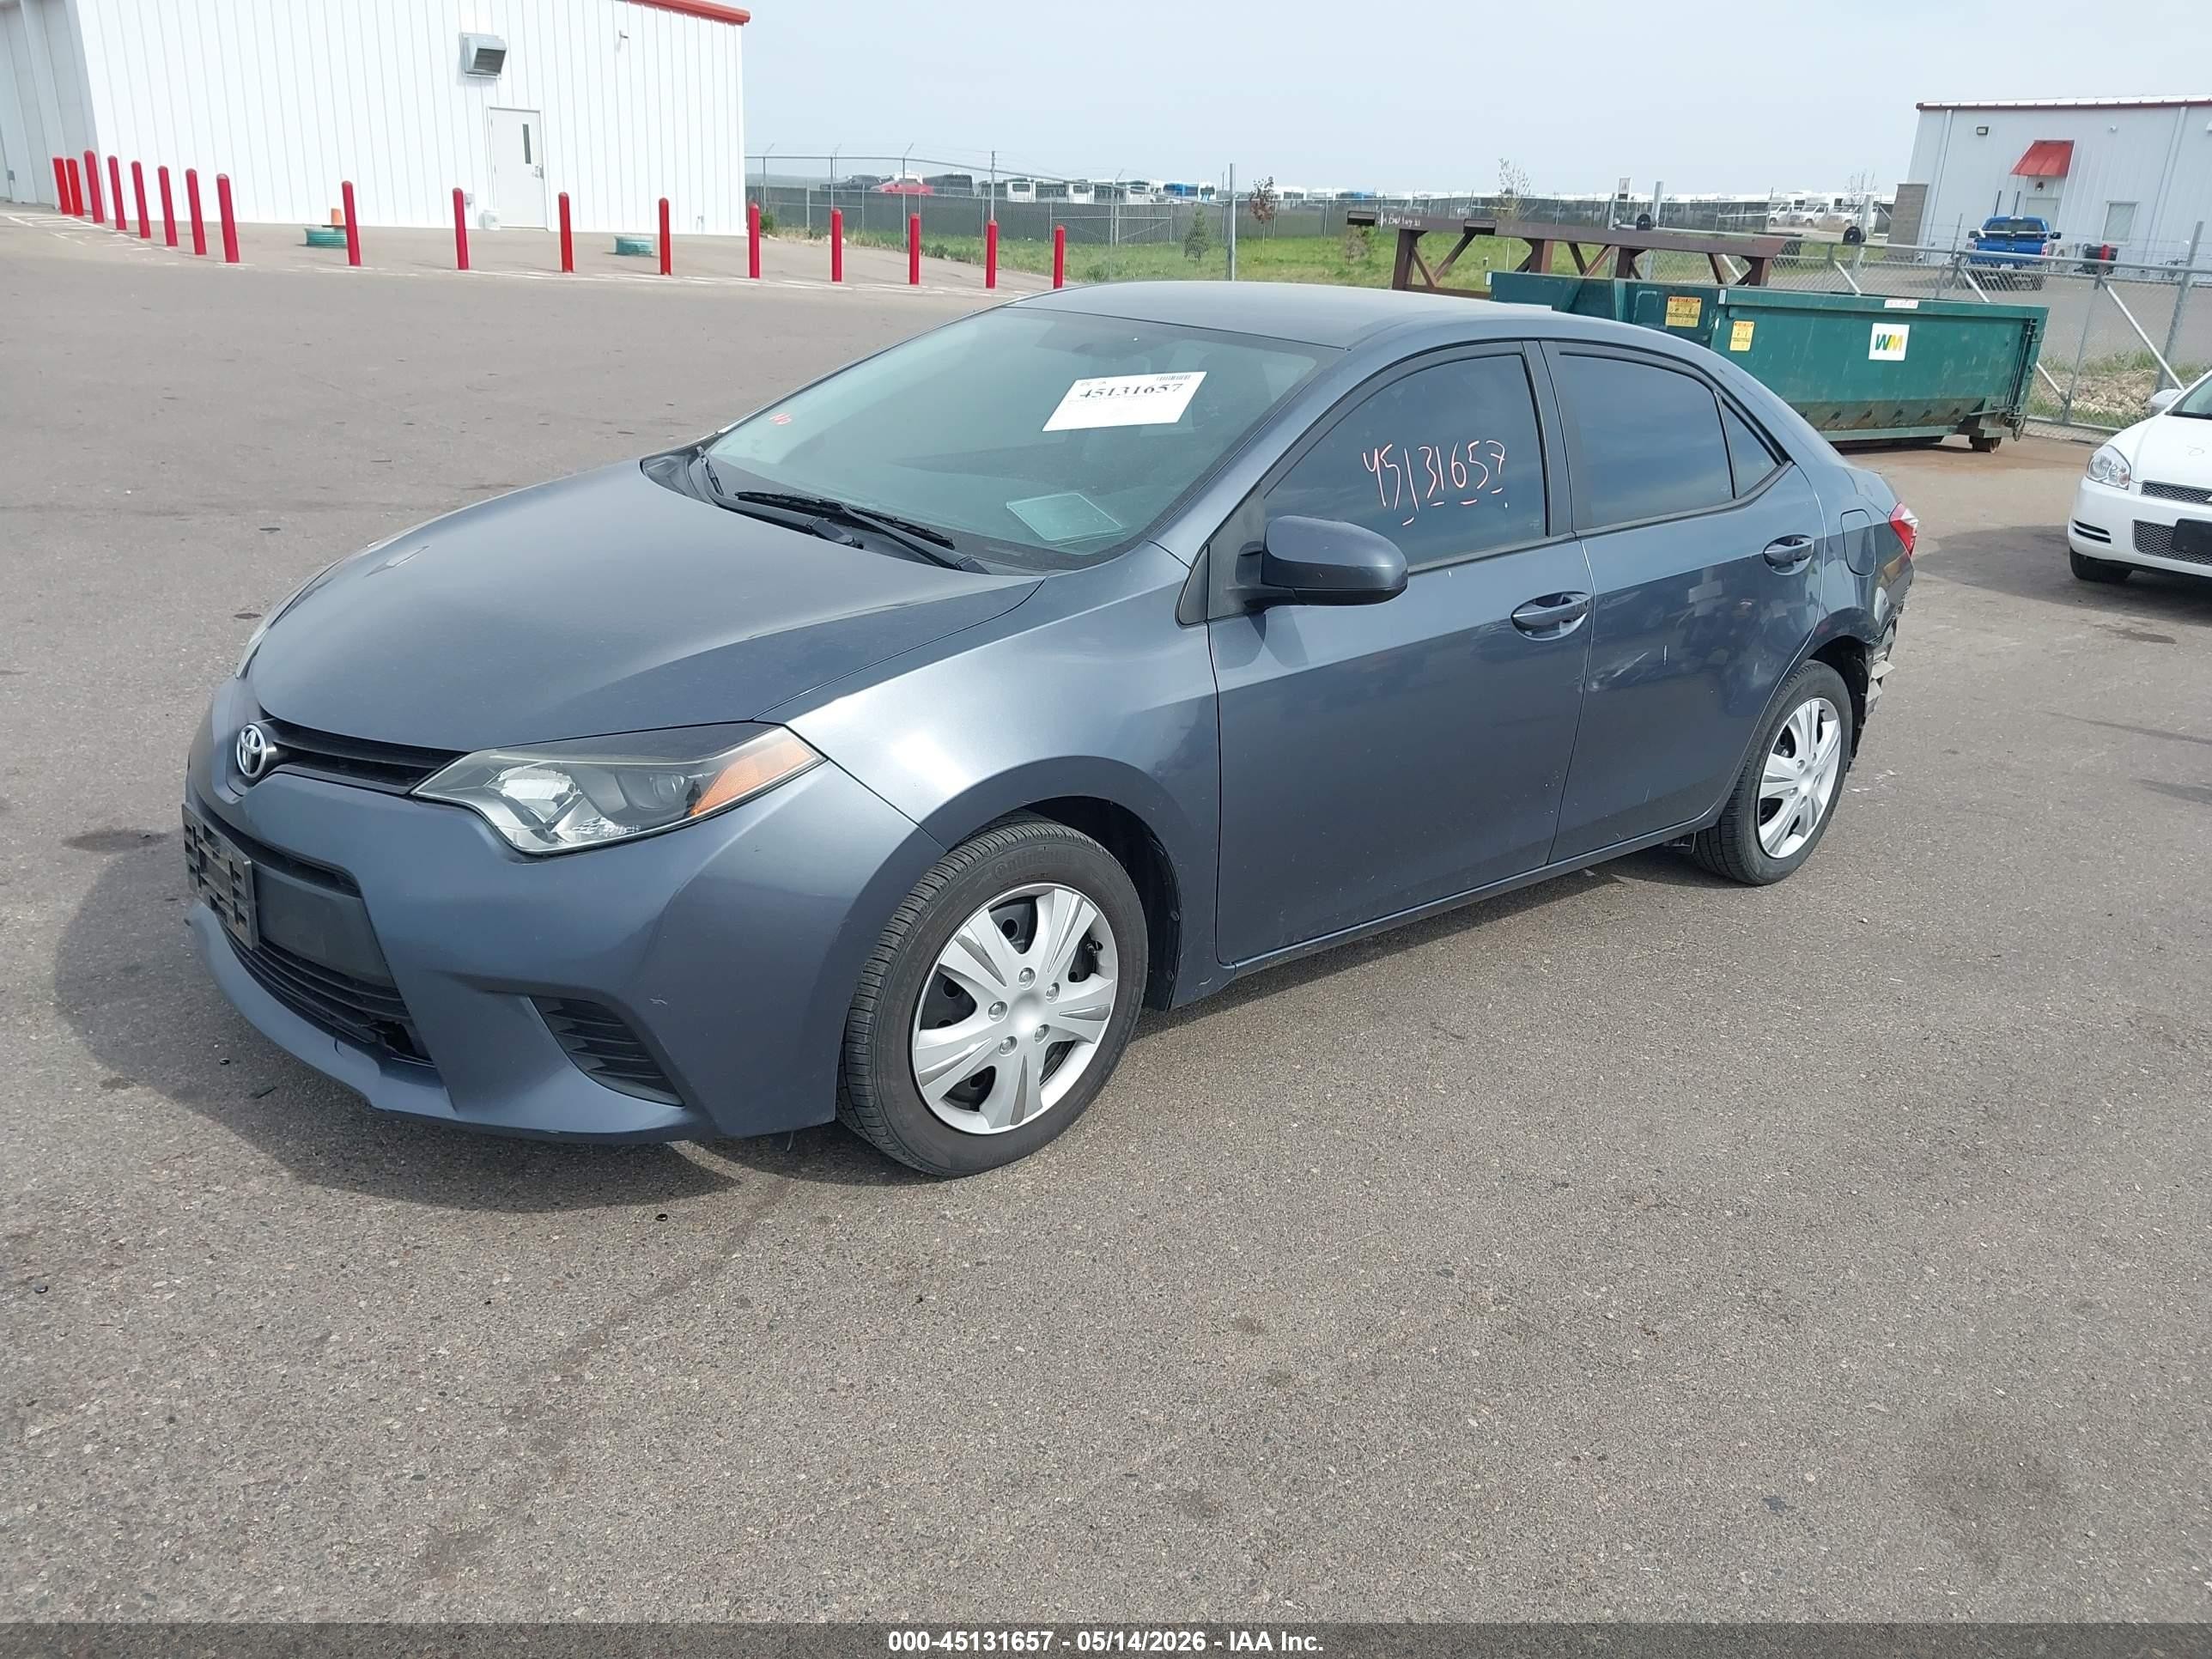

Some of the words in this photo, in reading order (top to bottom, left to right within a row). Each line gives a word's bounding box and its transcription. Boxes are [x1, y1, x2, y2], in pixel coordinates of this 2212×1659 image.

[1875, 333, 1904, 351] WM
[1079, 383, 1184, 398] 45131657
[1363, 440, 1506, 513] 45131657
